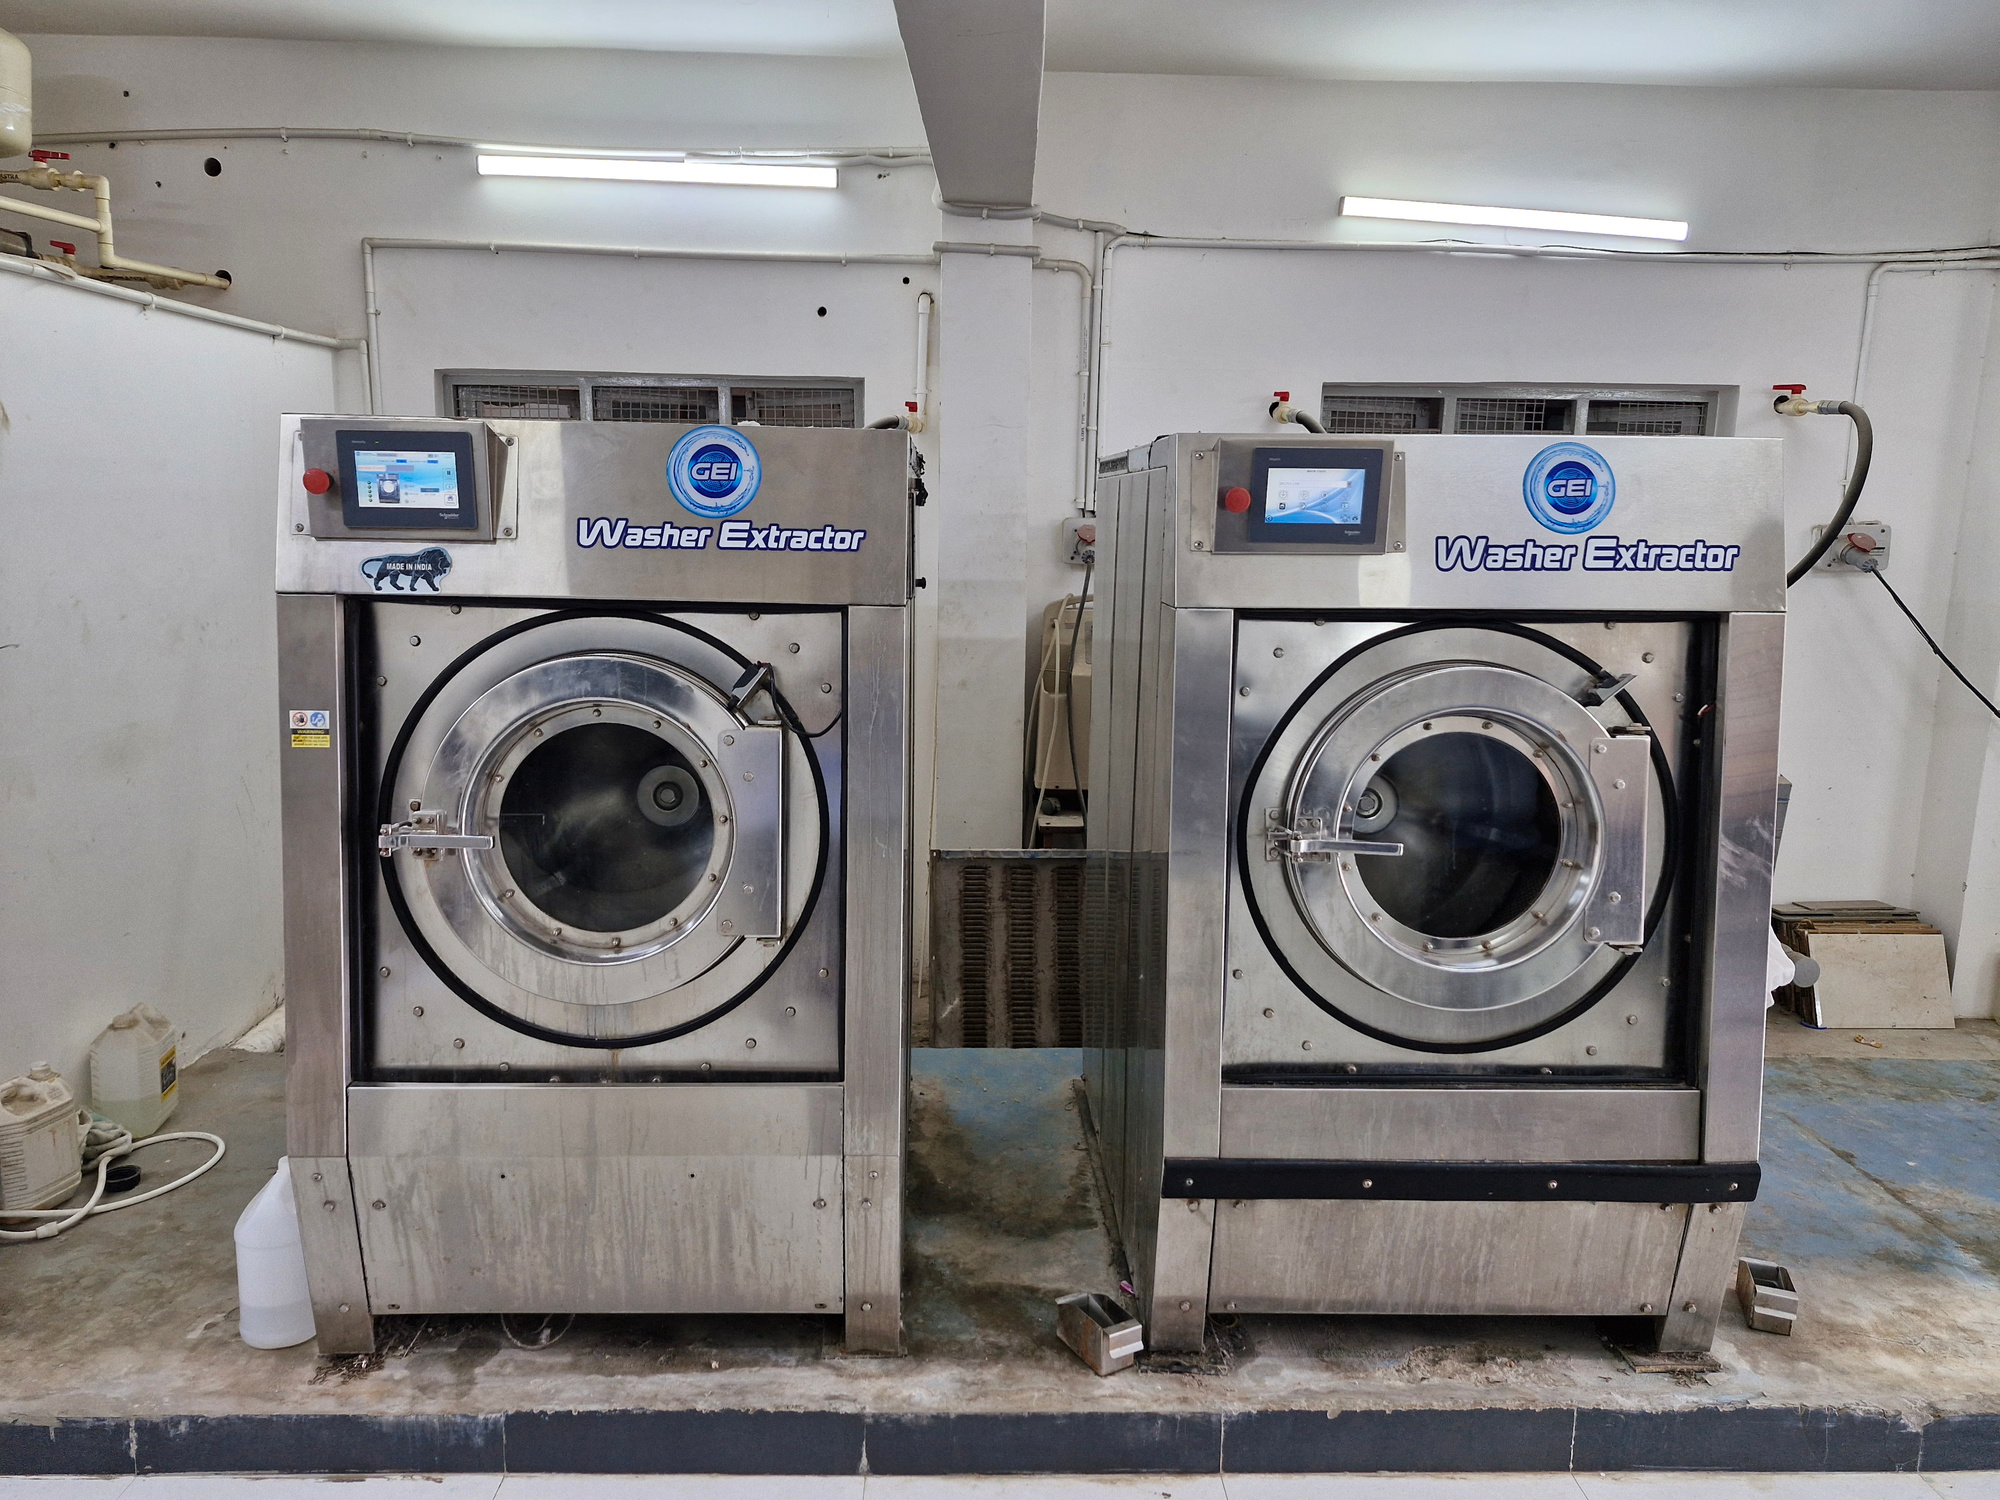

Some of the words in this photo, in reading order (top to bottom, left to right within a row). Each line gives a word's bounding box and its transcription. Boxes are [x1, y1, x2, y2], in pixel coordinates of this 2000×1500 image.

[691, 462, 738, 481] GEI
[1547, 479, 1593, 498] GEI
[577, 517, 714, 549] Washer
[717, 519, 867, 552] Extractor
[1435, 535, 1578, 571] Washer
[1582, 536, 1740, 571] Extractor
[386, 562, 405, 571] MADE
[405, 563, 413, 571] IN
[414, 563, 432, 571] INDIA
